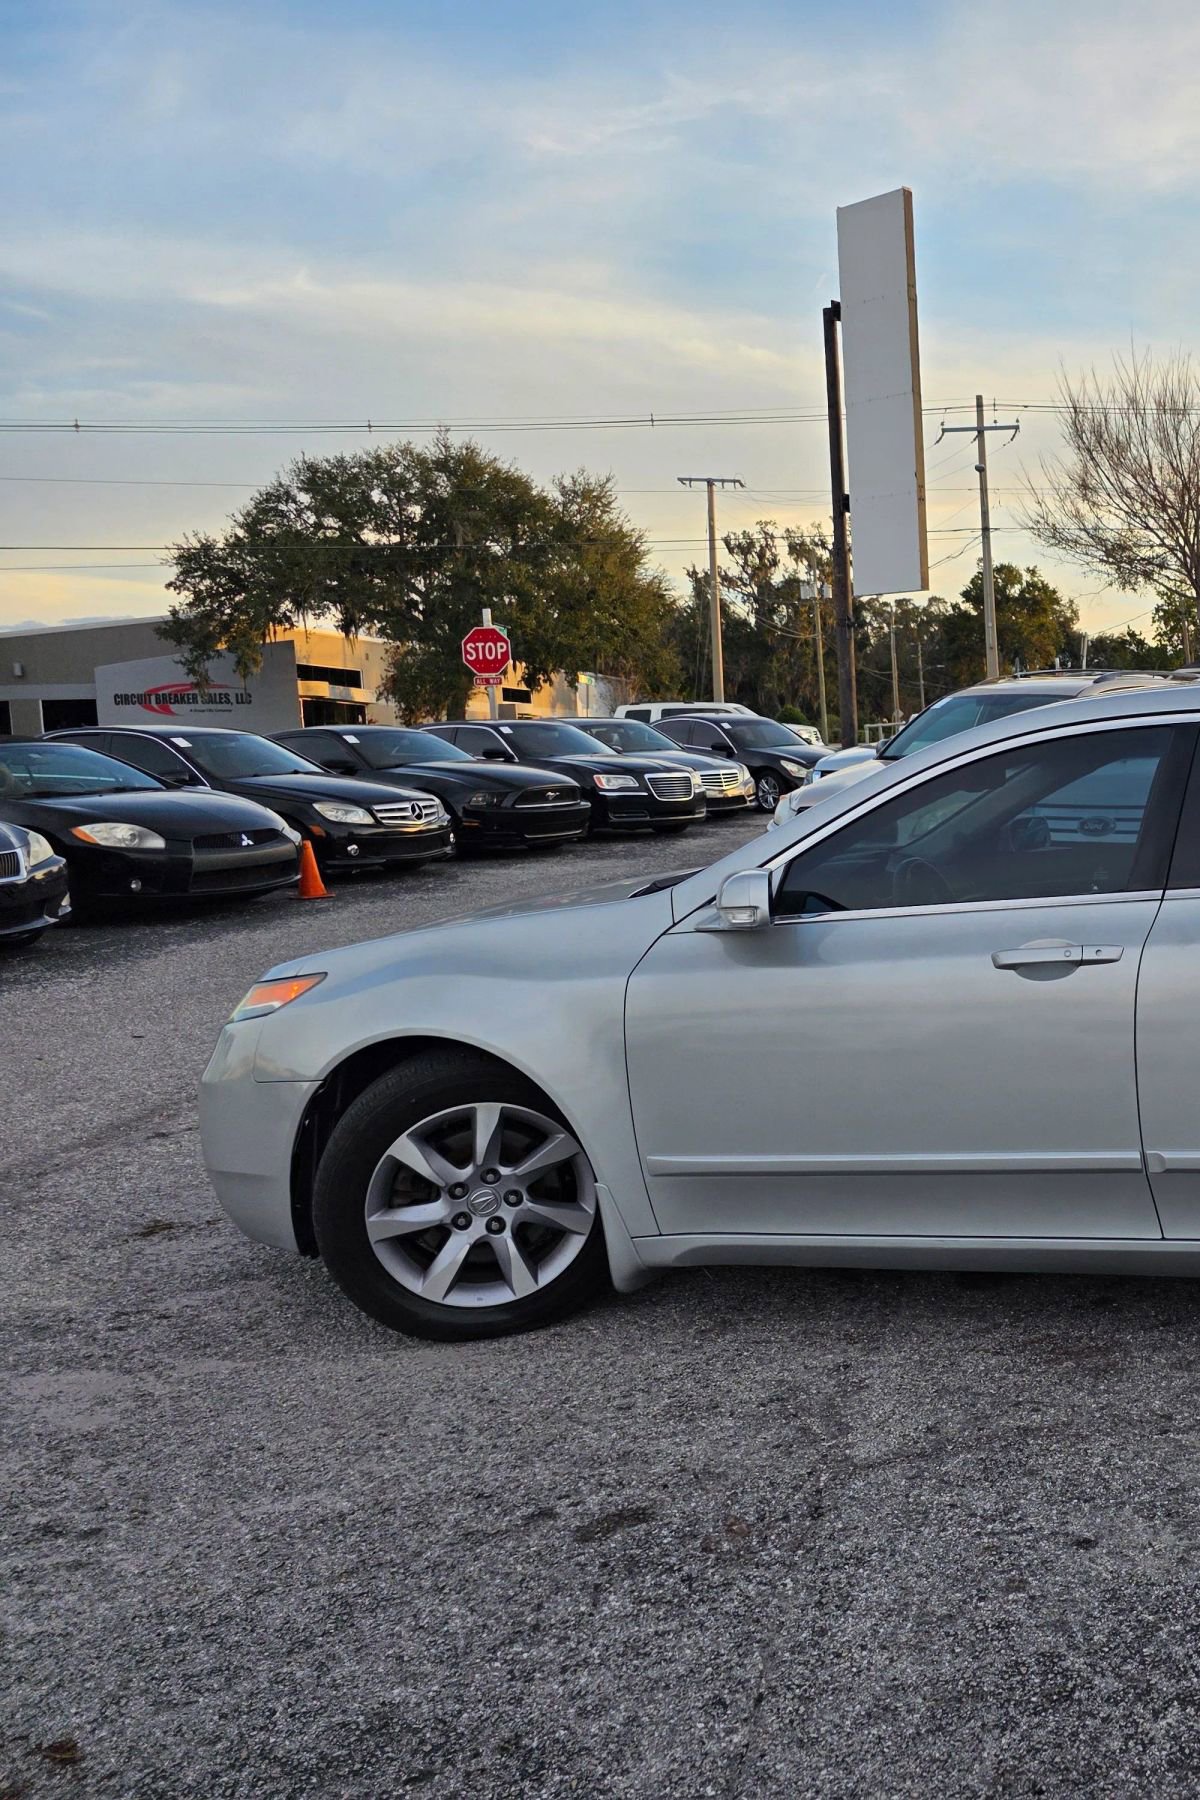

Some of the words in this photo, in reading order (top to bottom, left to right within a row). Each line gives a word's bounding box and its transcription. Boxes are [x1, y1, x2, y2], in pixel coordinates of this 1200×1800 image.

[466, 642, 507, 660] STOP
[113, 693, 152, 705] CIRCUIT
[155, 693, 199, 705] BREAKER
[235, 692, 253, 705] LLC
